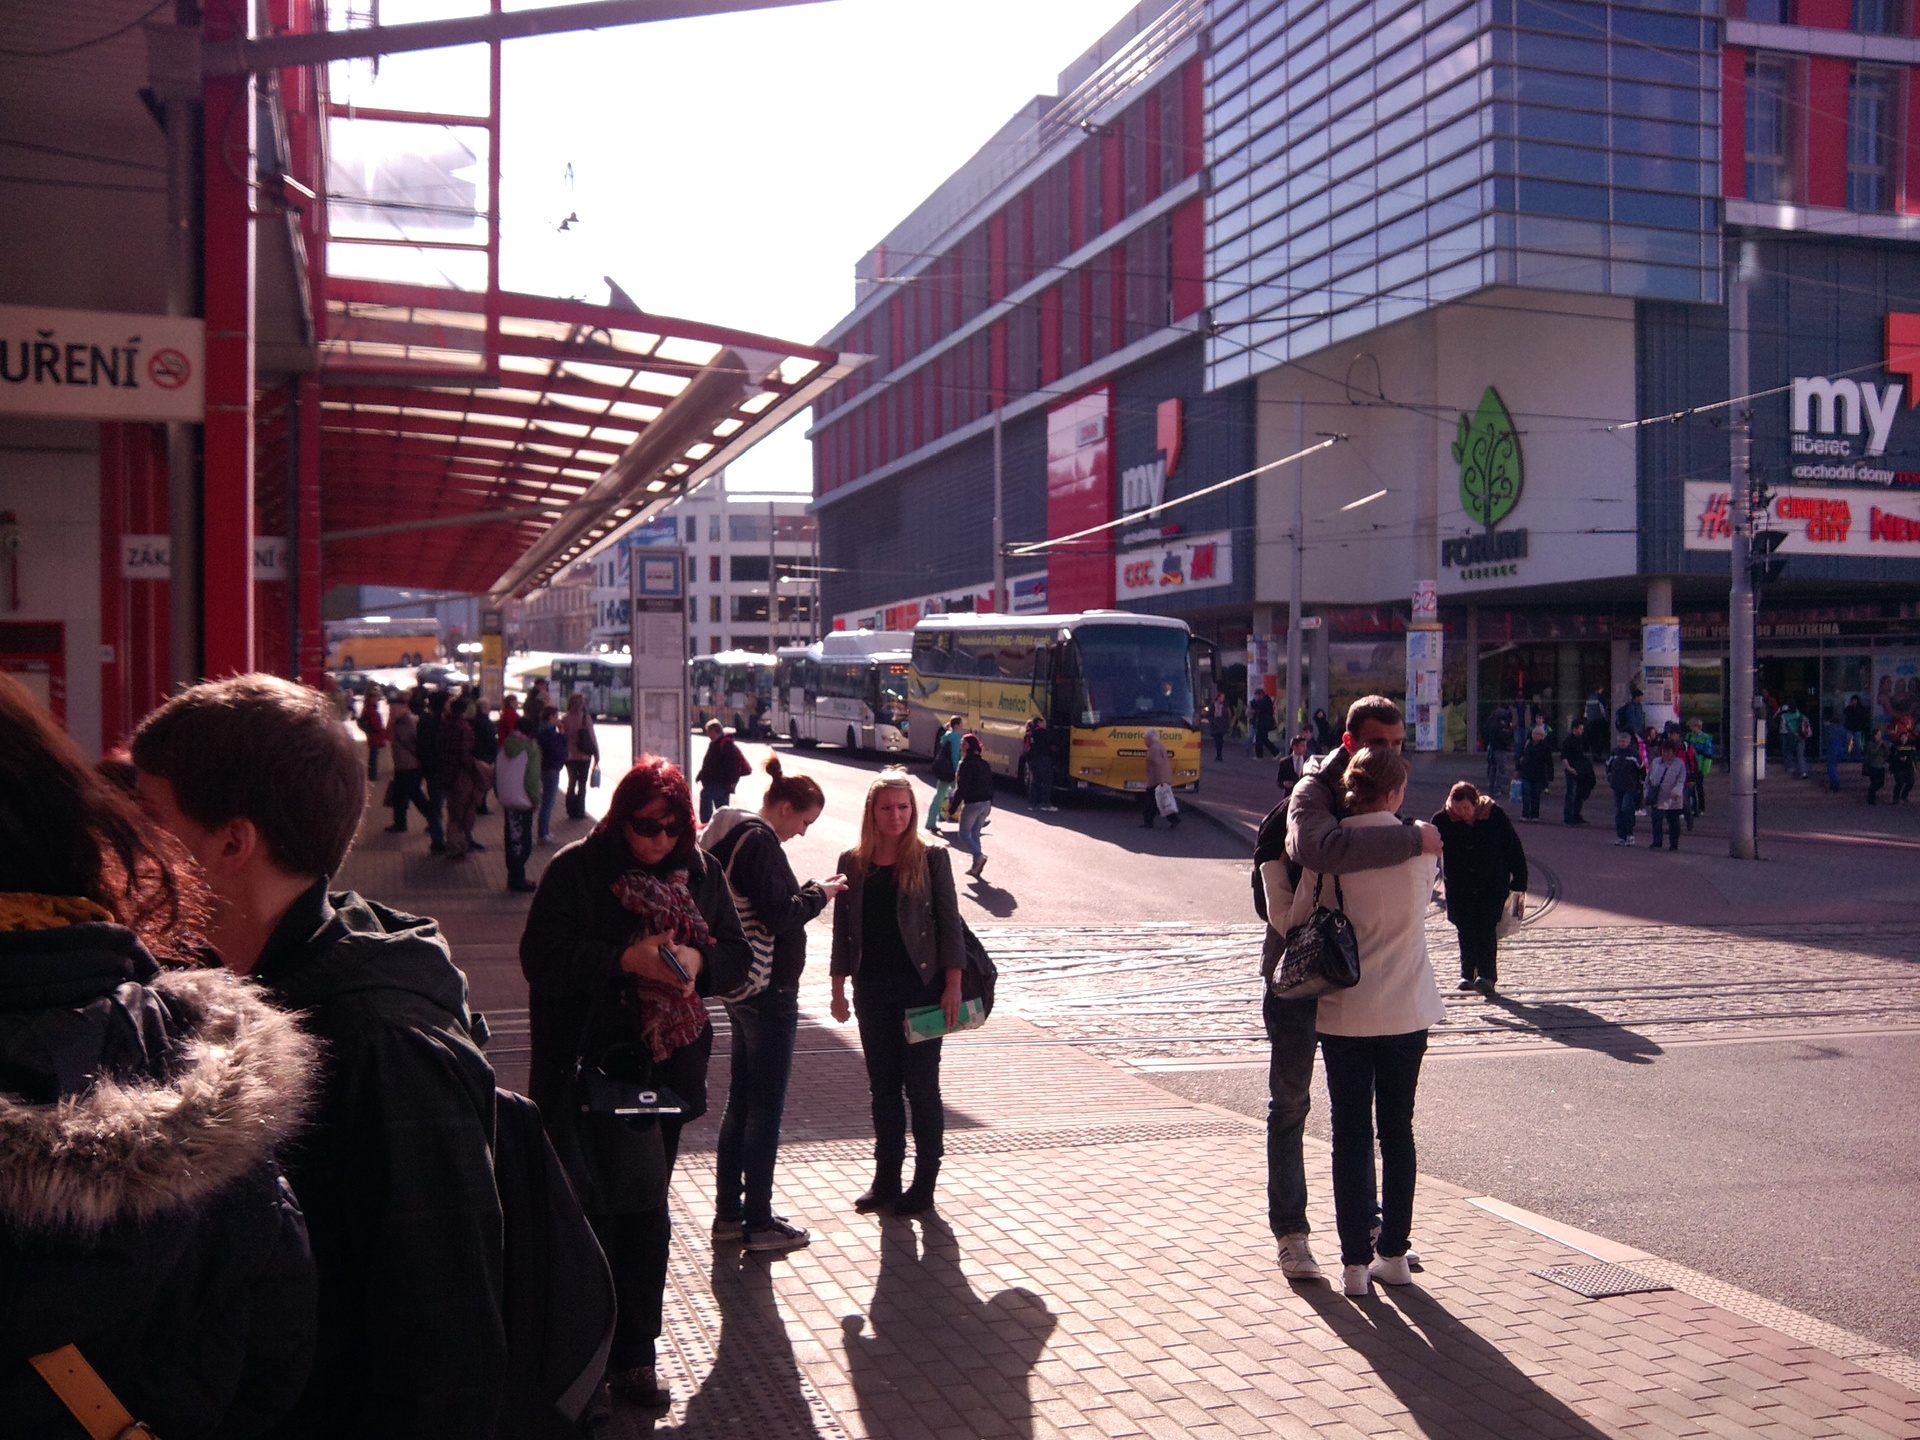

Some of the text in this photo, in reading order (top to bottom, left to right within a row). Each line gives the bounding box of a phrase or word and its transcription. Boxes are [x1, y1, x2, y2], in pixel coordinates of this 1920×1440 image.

[1790, 376, 1903, 456] my
[1792, 434, 1851, 457] liberec
[1793, 463, 1856, 481] obchodní
[1858, 467, 1895, 486] domy
[1122, 459, 1166, 519] my
[1777, 496, 1851, 521] CINEMA
[1807, 518, 1851, 543] CITY
[128, 542, 171, 568] ZÁK
[1441, 527, 1528, 569] FORUM
[1124, 560, 1155, 589] CCC
[1460, 563, 1518, 580] LIBEREC
[1776, 623, 1840, 636] MULTIKINA
[1108, 728, 1184, 741] Americ Tours
